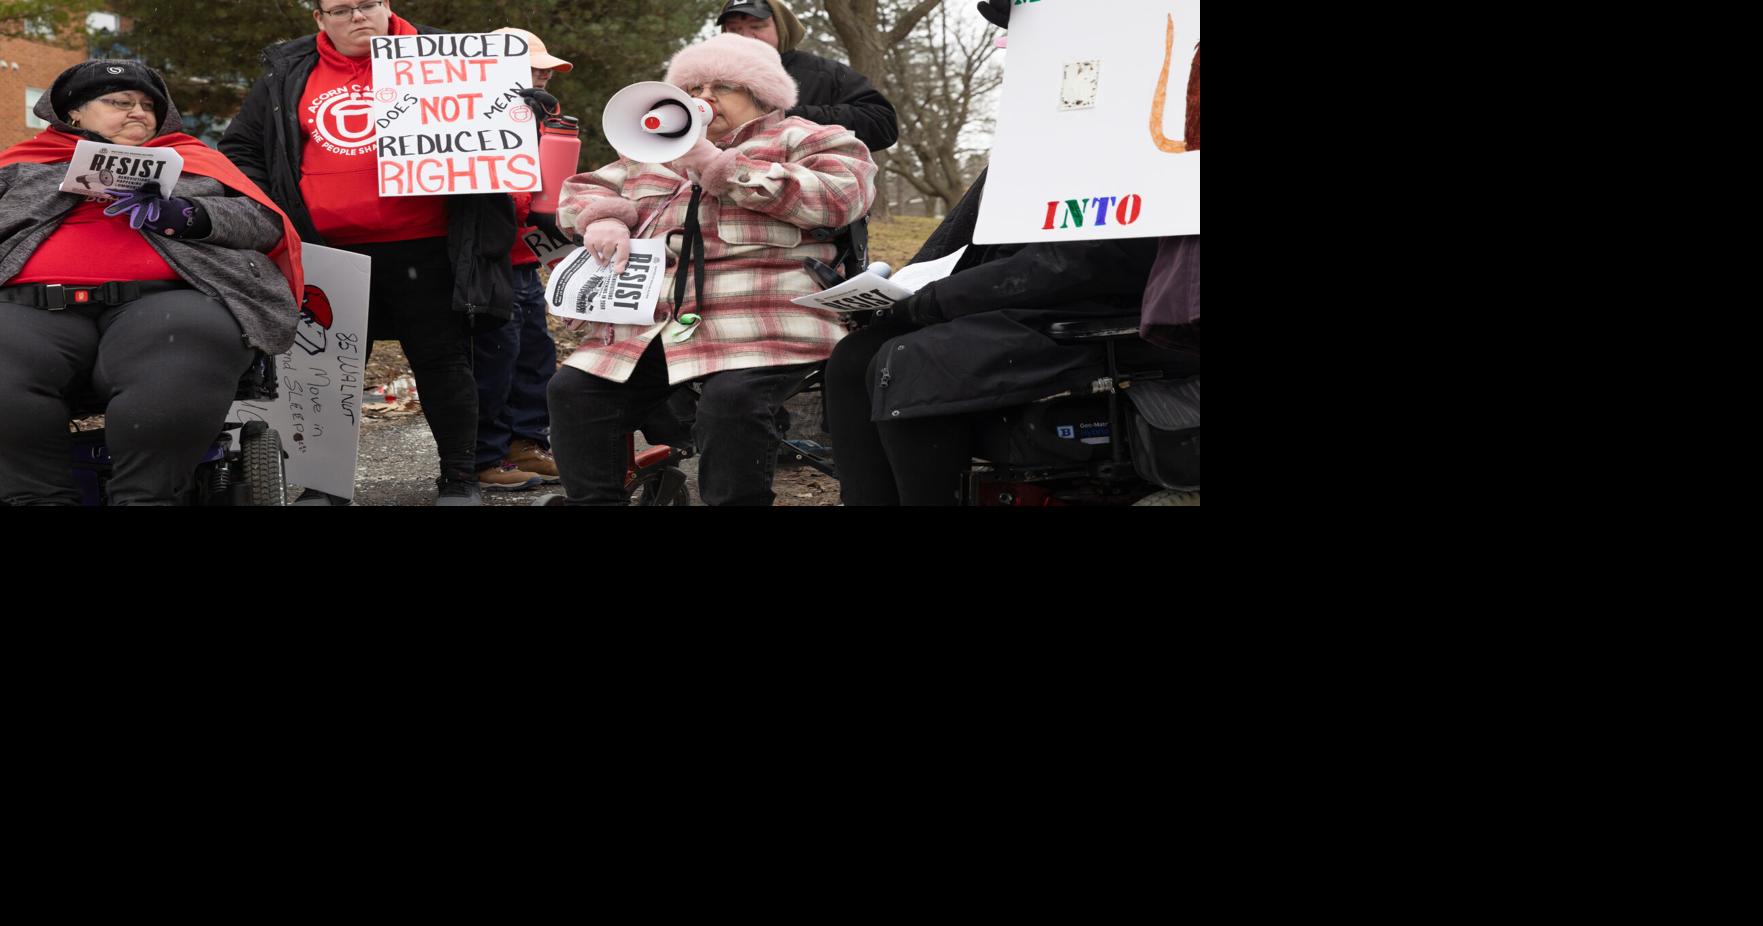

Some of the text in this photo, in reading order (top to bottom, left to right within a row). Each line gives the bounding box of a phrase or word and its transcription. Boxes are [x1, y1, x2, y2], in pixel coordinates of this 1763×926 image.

[372, 33, 528, 59] REDUCED
[394, 59, 498, 85] RENT
[308, 84, 374, 113] ACORN CA
[376, 82, 525, 129] DOES NOT MEAN
[311, 129, 324, 143] THE
[321, 141, 357, 156] PEOPLE
[378, 129, 523, 157] REDUCED
[89, 153, 167, 179] RESIST
[380, 154, 538, 194] RIGHTS
[1041, 194, 1142, 230] INTO
[613, 253, 652, 310] RESIST
[336, 332, 360, 426] 85 WALNUT
[307, 367, 331, 438] Move in
